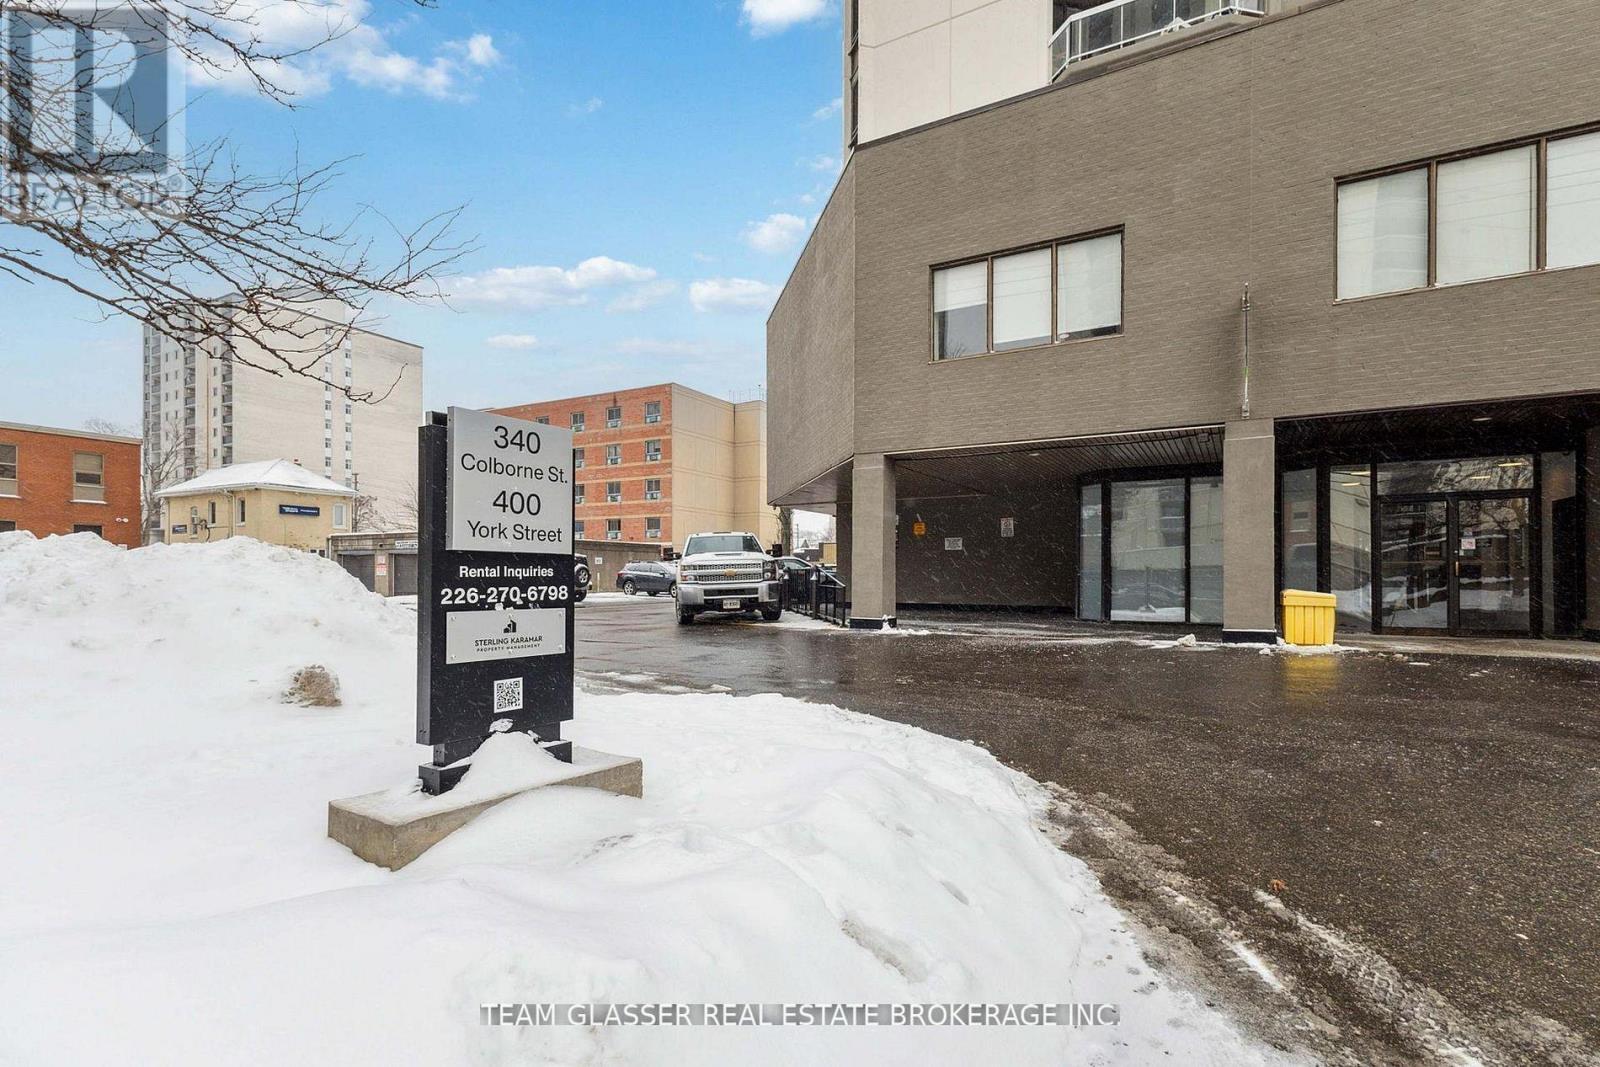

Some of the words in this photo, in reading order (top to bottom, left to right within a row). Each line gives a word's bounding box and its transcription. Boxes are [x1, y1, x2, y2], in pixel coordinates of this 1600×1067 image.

[493, 425, 541, 454] 340
[460, 453, 544, 480] Colborne
[548, 466, 568, 484] St.
[492, 490, 541, 516] 400
[467, 520, 508, 540] York
[512, 523, 562, 543] Street
[459, 565, 500, 578] Rental
[503, 565, 554, 580] Inquiries
[440, 586, 569, 605] 226-270-6798
[474, 637, 509, 647] STERLING
[510, 635, 543, 644] KARAMAR
